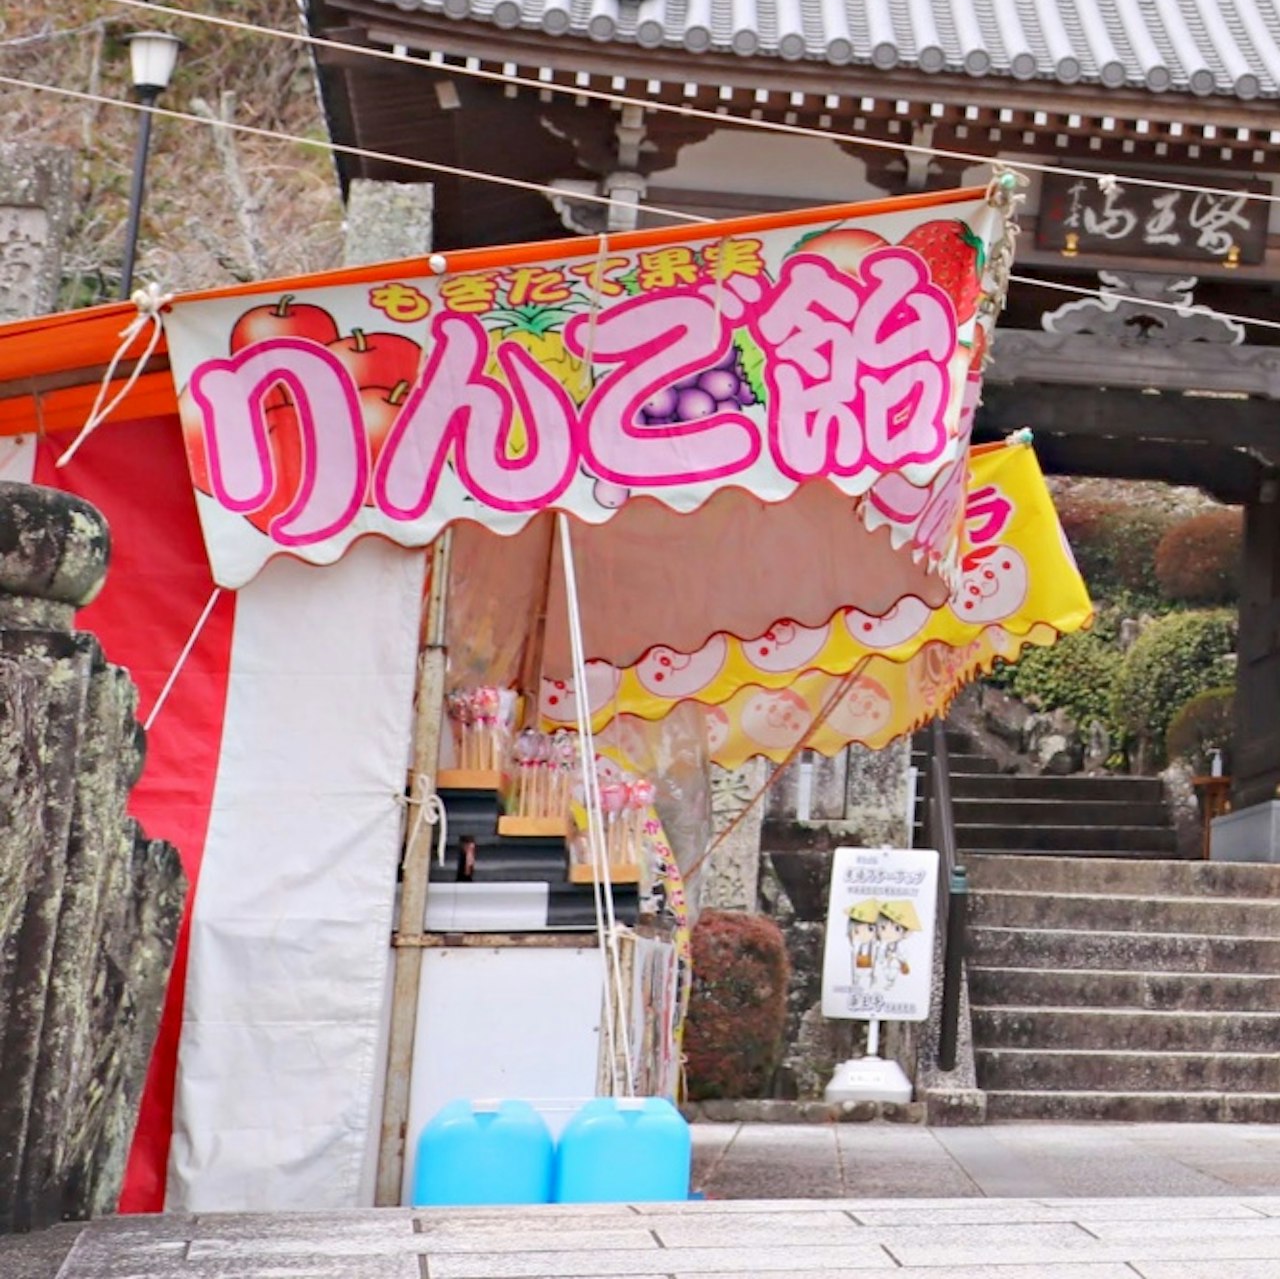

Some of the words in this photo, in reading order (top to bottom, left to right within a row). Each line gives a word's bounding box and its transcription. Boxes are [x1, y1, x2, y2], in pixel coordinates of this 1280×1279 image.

[368, 237, 763, 323] もぎたて果実
[191, 245, 958, 547] りんご飴
